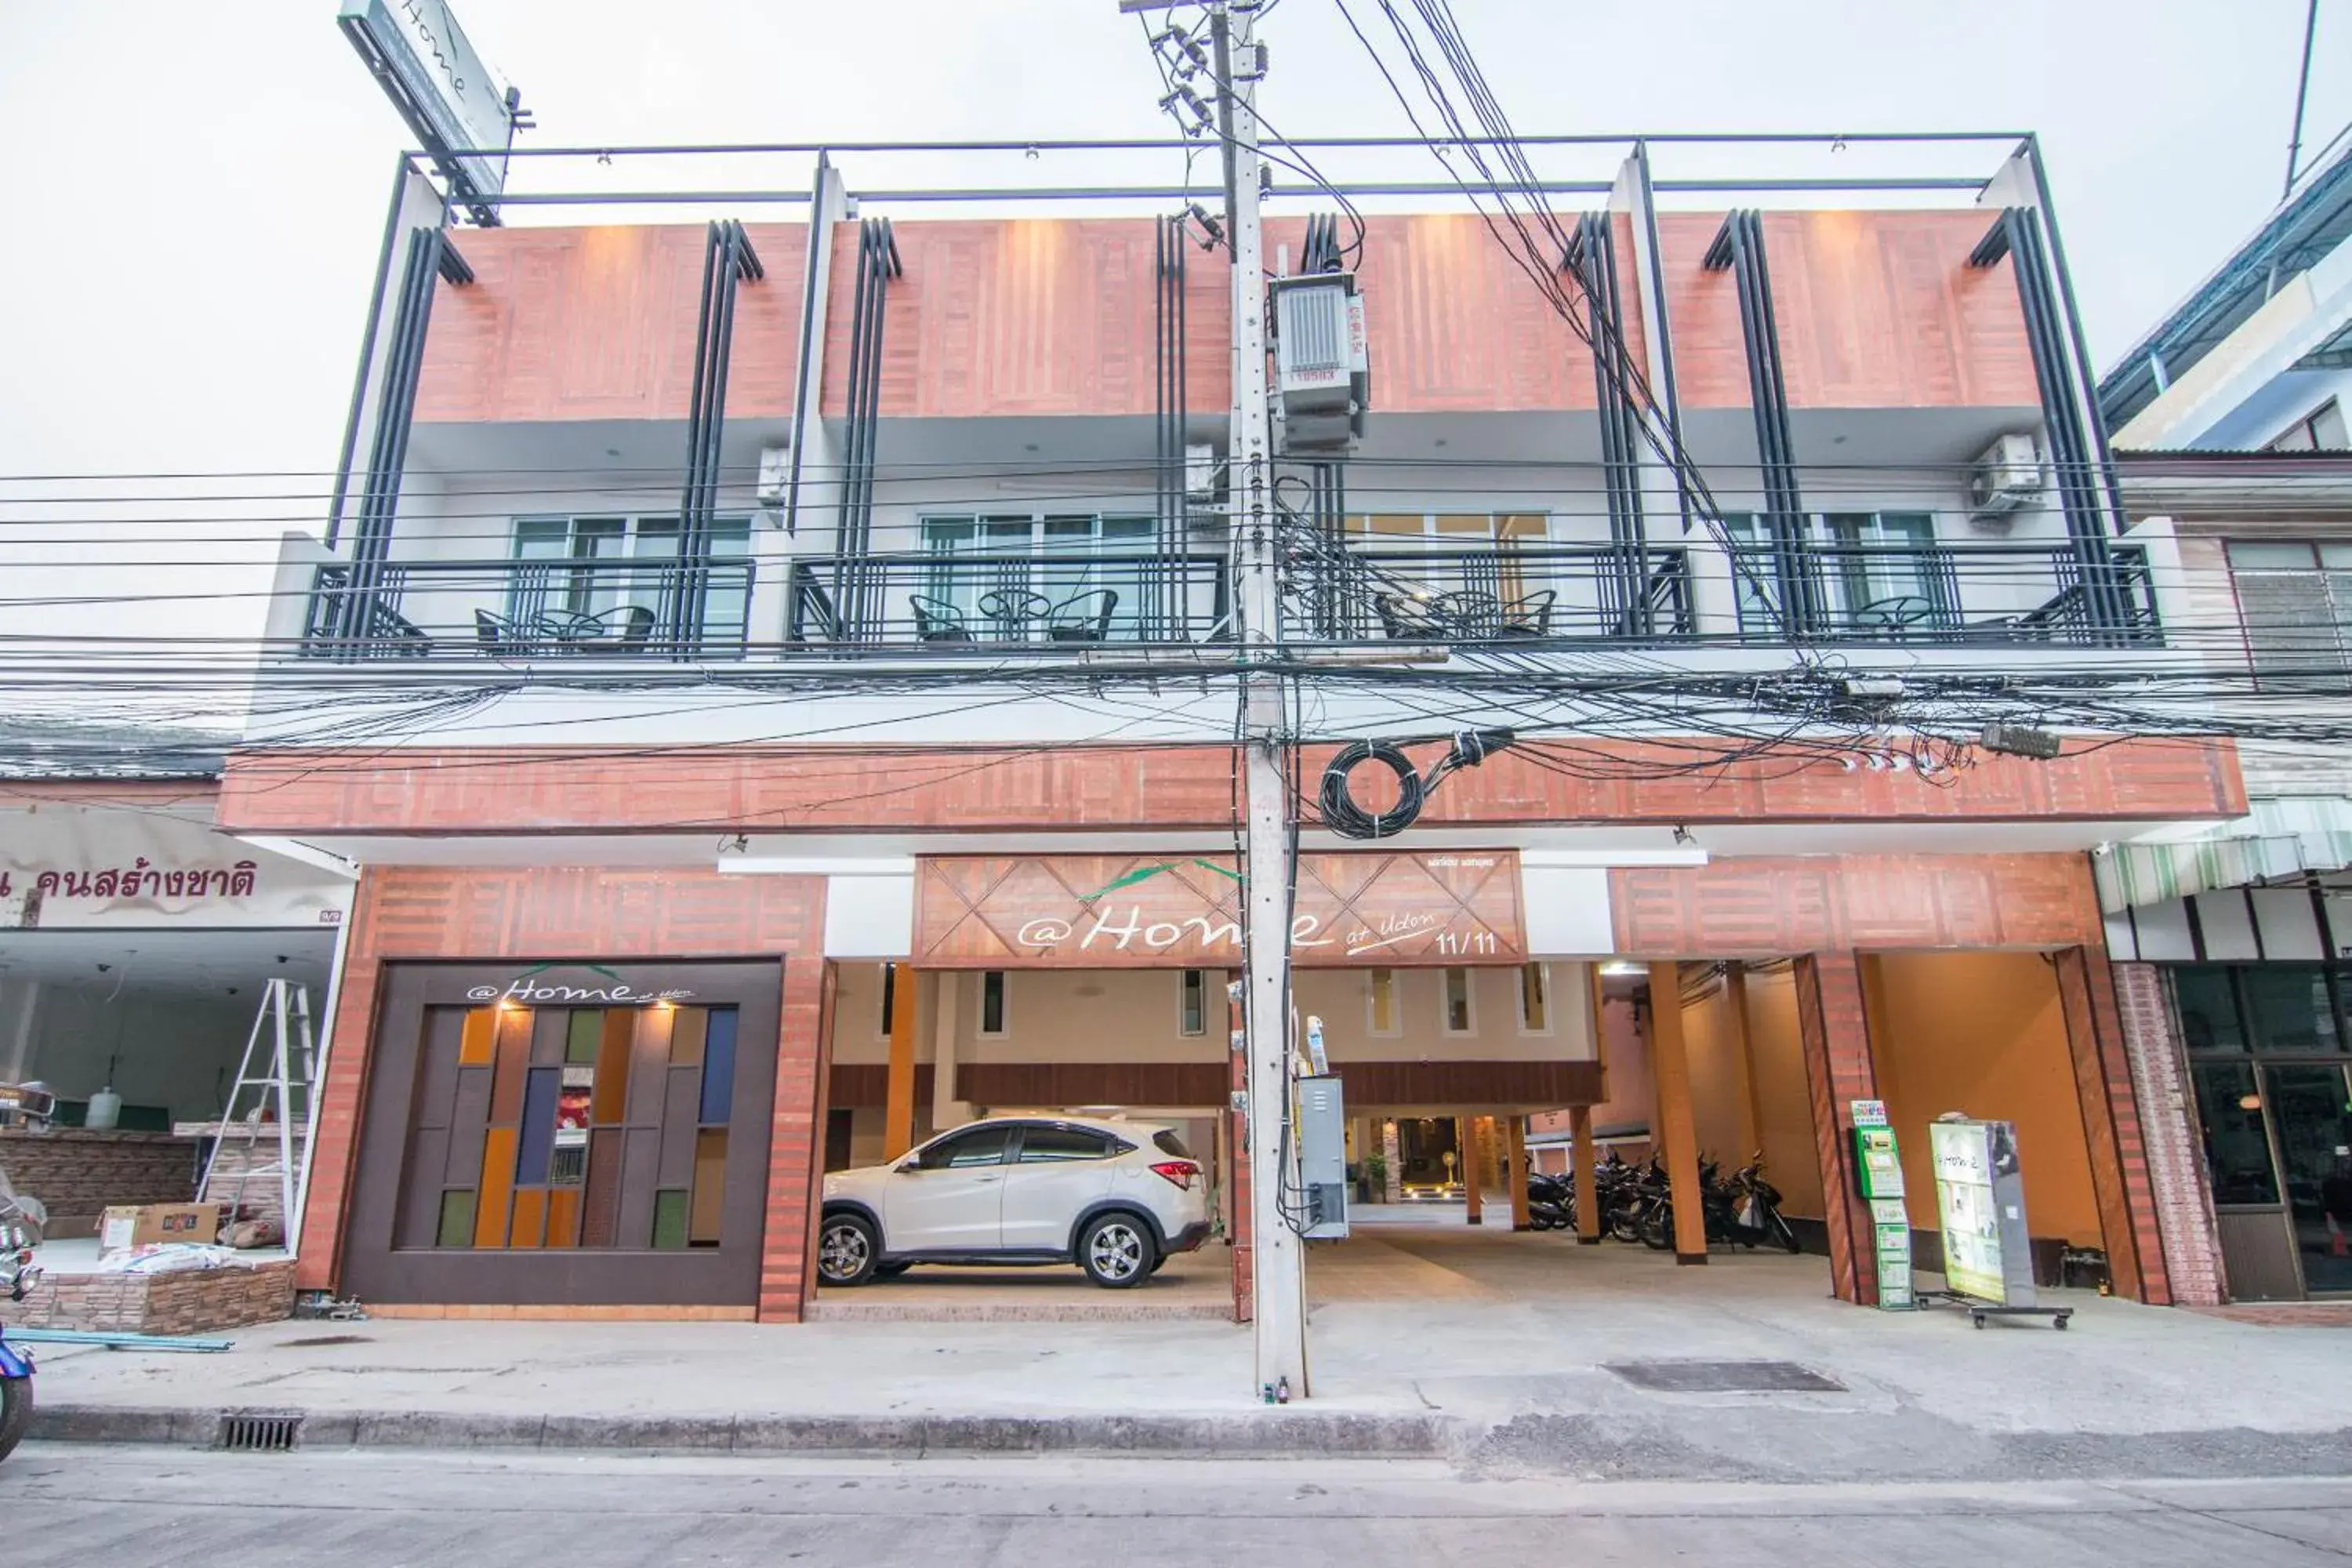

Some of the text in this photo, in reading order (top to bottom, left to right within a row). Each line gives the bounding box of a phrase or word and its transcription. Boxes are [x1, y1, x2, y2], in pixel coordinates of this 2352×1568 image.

[37, 857, 258, 898] คนสร้างชาติ
[1381, 913, 1436, 935] Udon
[1436, 931, 1495, 954] 11/11
